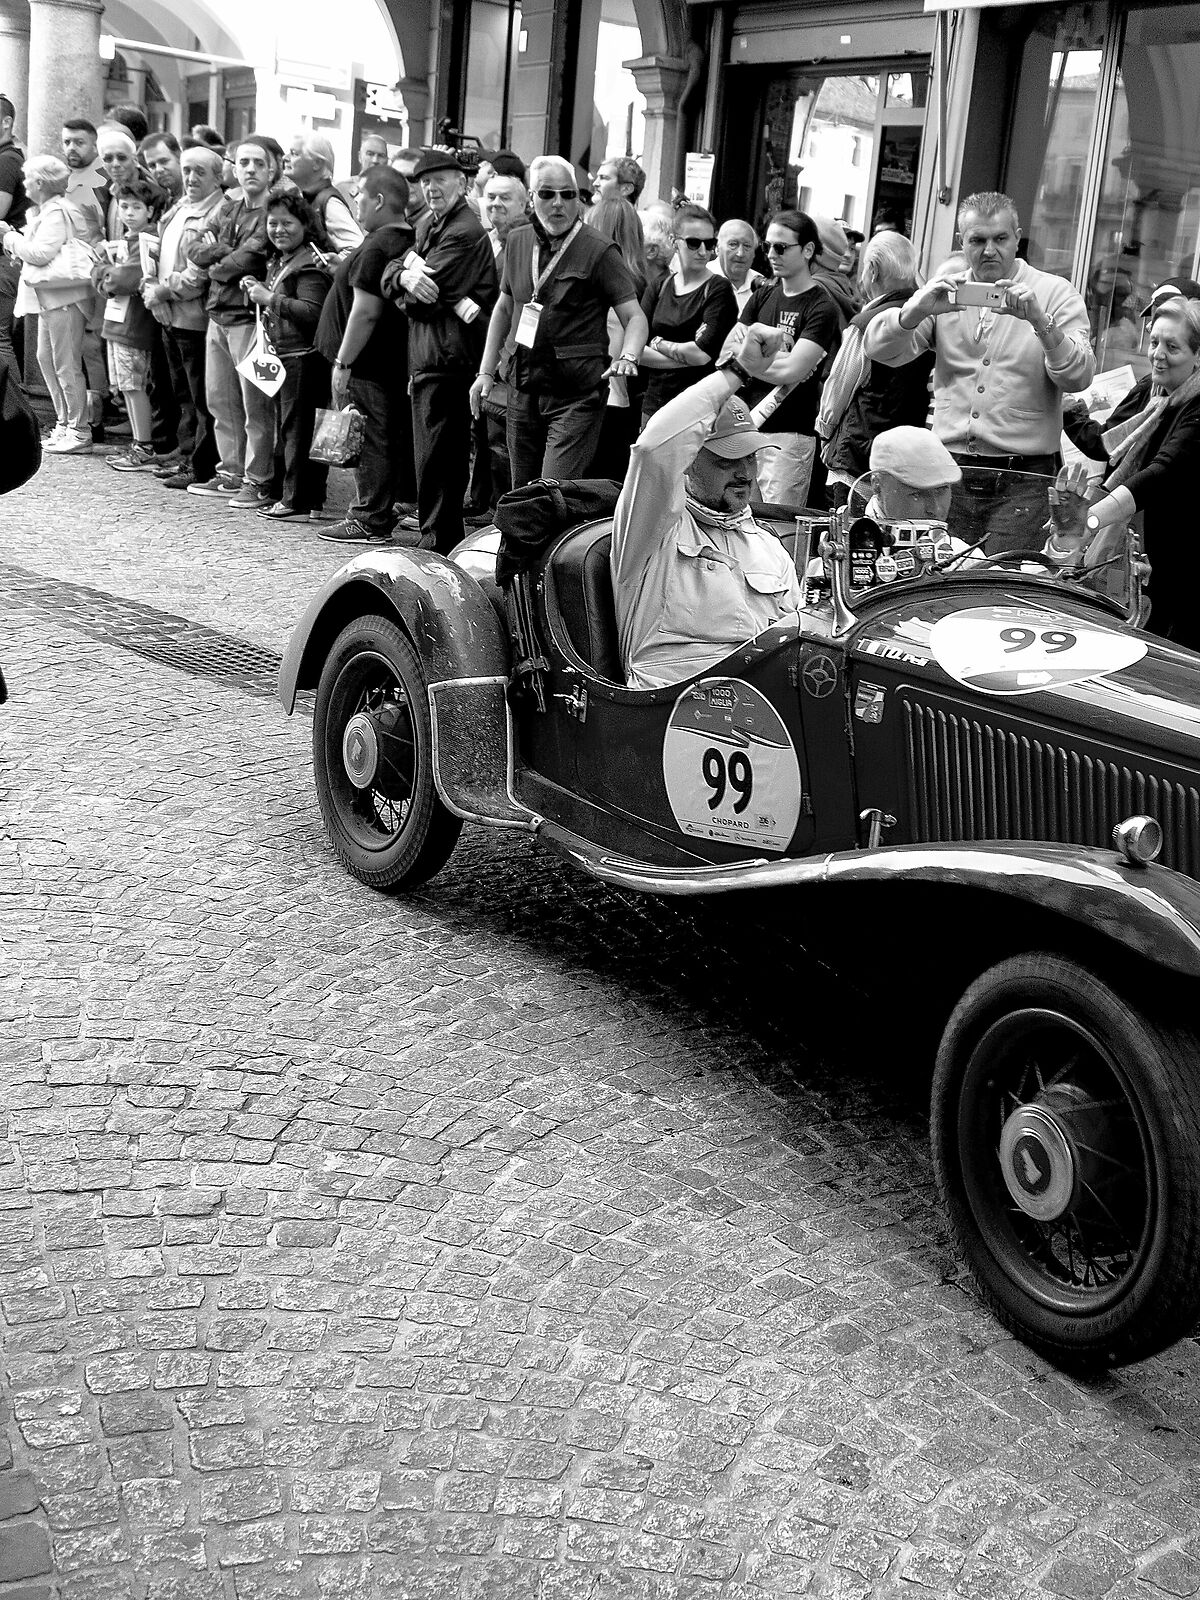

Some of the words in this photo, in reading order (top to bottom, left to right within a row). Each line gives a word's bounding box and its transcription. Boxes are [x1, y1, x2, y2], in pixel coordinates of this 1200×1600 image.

[999, 627, 1077, 654] 99
[711, 688, 731, 698] 1000
[702, 747, 753, 815] 99
[711, 816, 750, 829] CHOPARD
